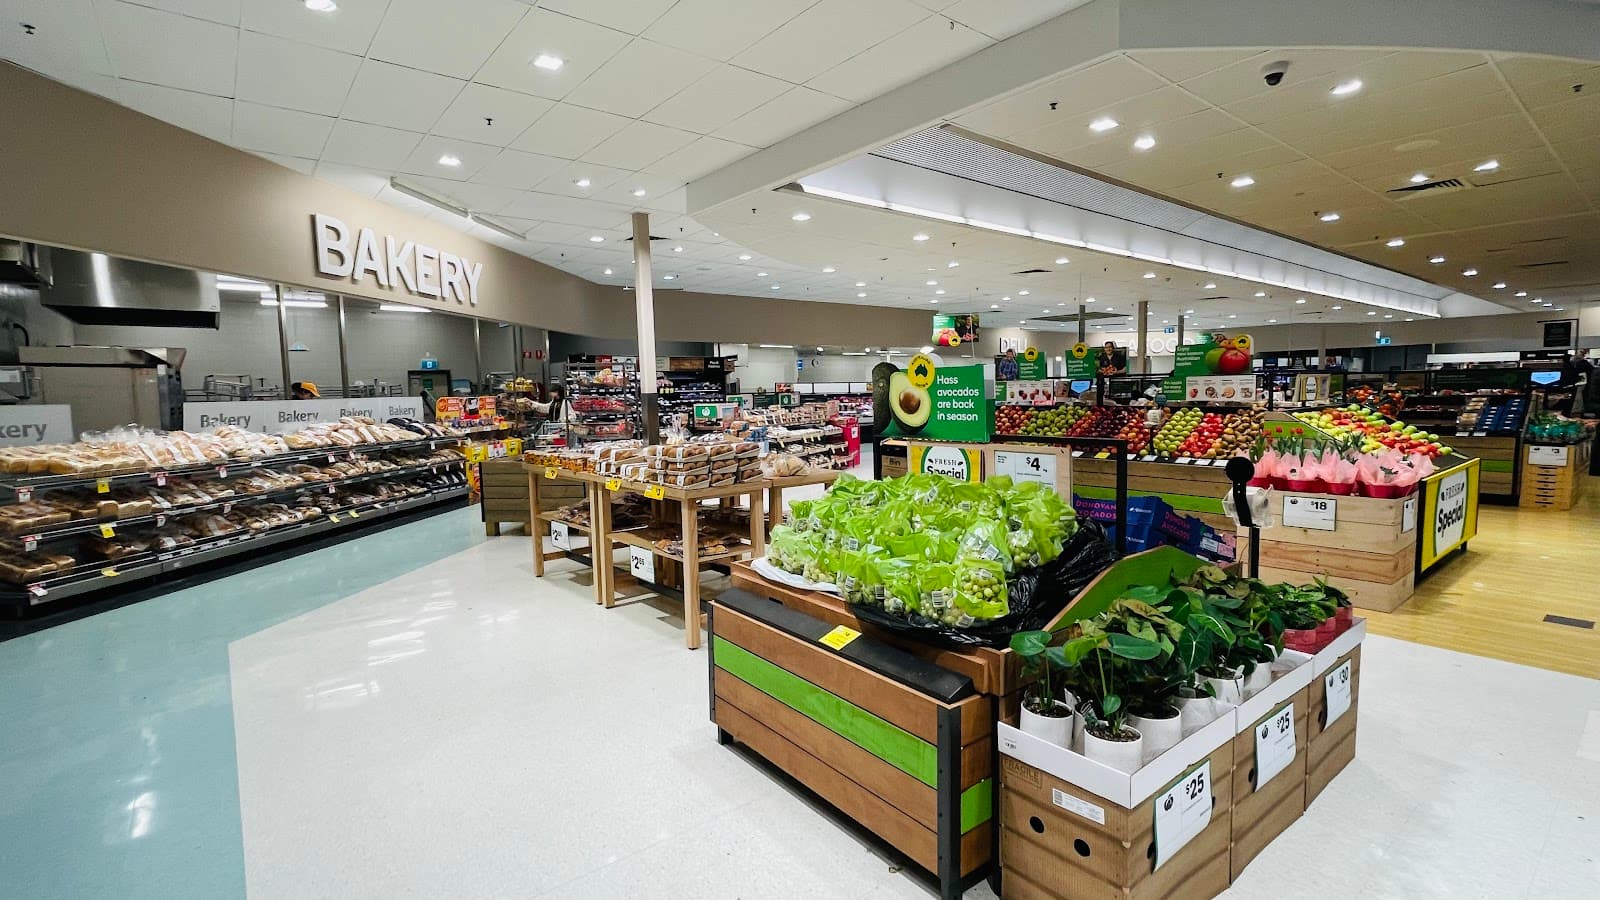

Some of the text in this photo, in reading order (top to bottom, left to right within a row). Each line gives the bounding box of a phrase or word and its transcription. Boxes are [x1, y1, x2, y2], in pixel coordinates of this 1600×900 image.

[311, 213, 482, 305] BAKERY
[936, 375, 959, 385] Hass
[936, 387, 980, 397] avocados
[936, 398, 975, 409] are back
[278, 410, 319, 424] Bakery
[340, 408, 373, 418] Bakery
[389, 405, 416, 418] Bakery
[936, 411, 979, 422] in season
[200, 413, 251, 429] Bakery
[1025, 456, 1041, 471] $4
[1076, 500, 1117, 510] DONOVAN
[1310, 500, 1327, 511] $18
[1077, 510, 1117, 520] OCADOS
[1438, 498, 1464, 538] Special
[1276, 711, 1290, 733] $25
[1185, 772, 1205, 800] $25
